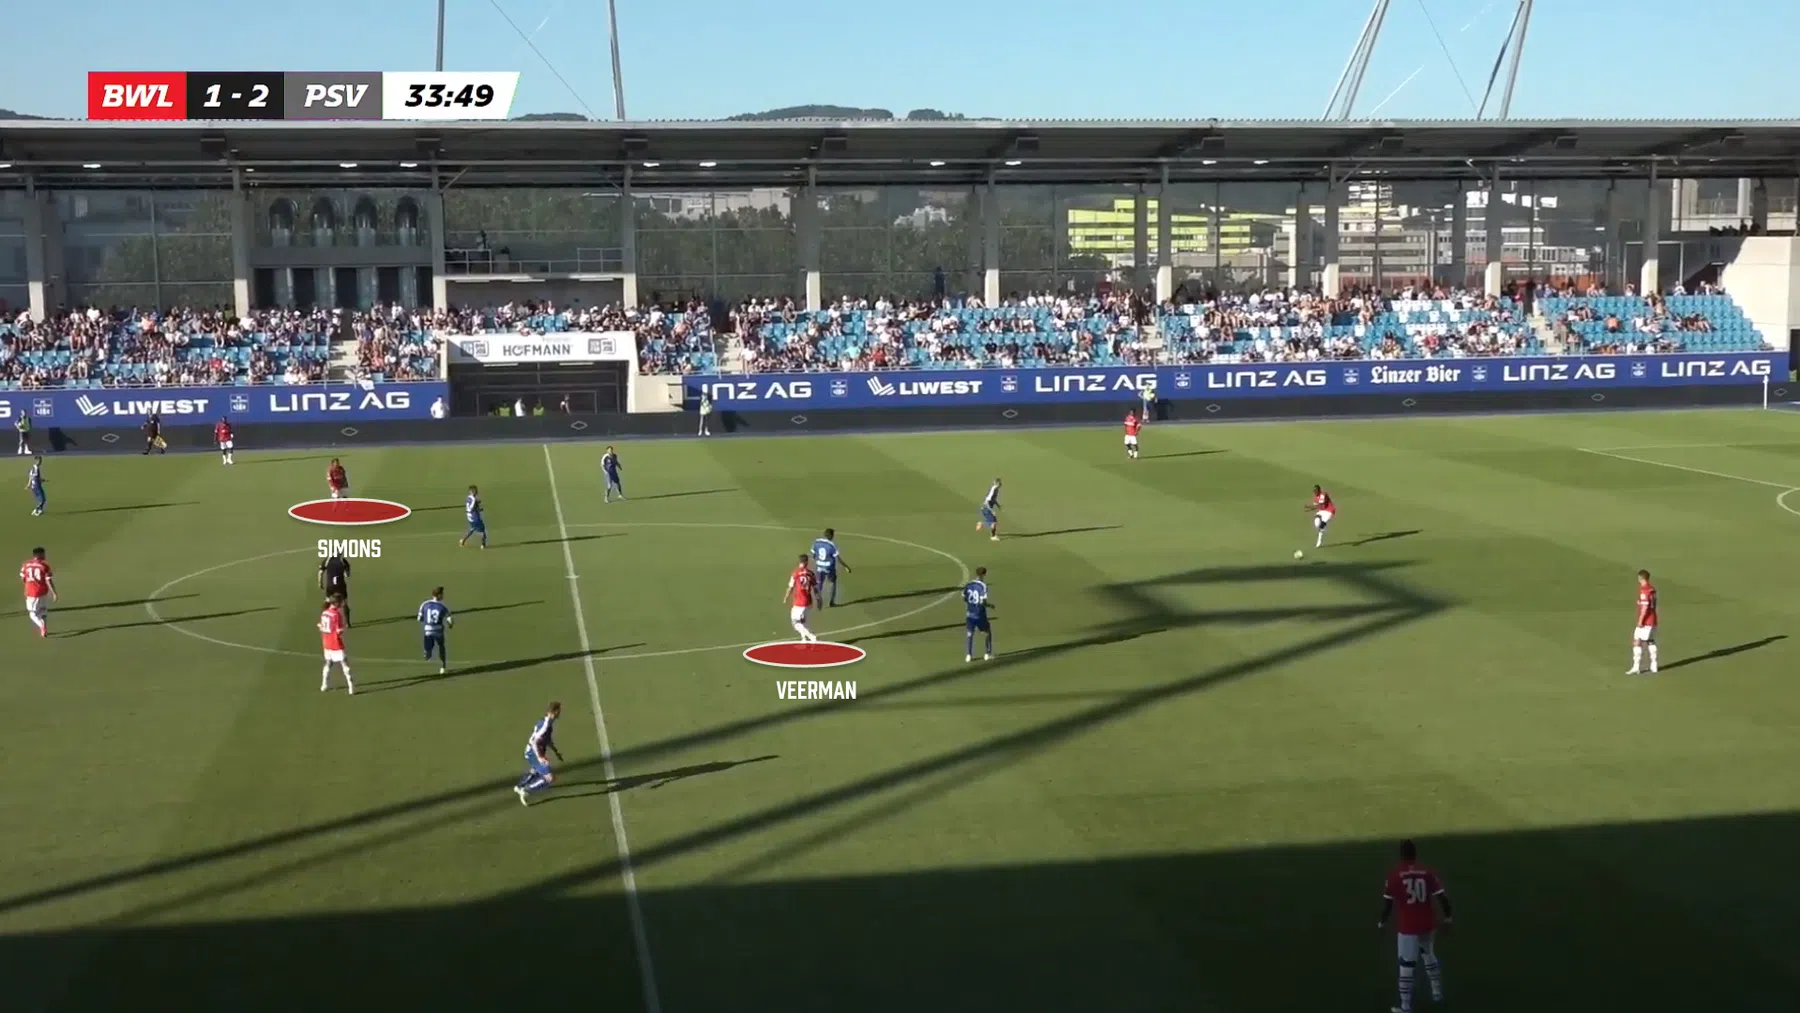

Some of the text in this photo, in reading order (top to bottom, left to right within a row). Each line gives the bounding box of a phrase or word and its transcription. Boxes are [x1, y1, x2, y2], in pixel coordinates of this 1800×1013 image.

[503, 343, 571, 356] HOFMANN
[1370, 365, 1422, 384] Linzer
[1426, 364, 1461, 383] Bier
[1503, 364, 1568, 382] LINZ
[1574, 363, 1615, 380] AG
[1661, 360, 1725, 377] LINZ
[1730, 359, 1770, 376] AG
[899, 380, 983, 396] LIWEST
[1035, 374, 1106, 393] LINZ
[1112, 373, 1157, 391] AG
[1207, 370, 1277, 389] LINZ
[1283, 369, 1326, 387] AG
[764, 381, 812, 399] AG
[113, 398, 209, 416] LIWEST
[270, 392, 351, 412] LINZ
[359, 391, 410, 410] AG
[818, 547, 827, 561] 9
[426, 608, 440, 624] 13
[1402, 878, 1426, 904] 30
